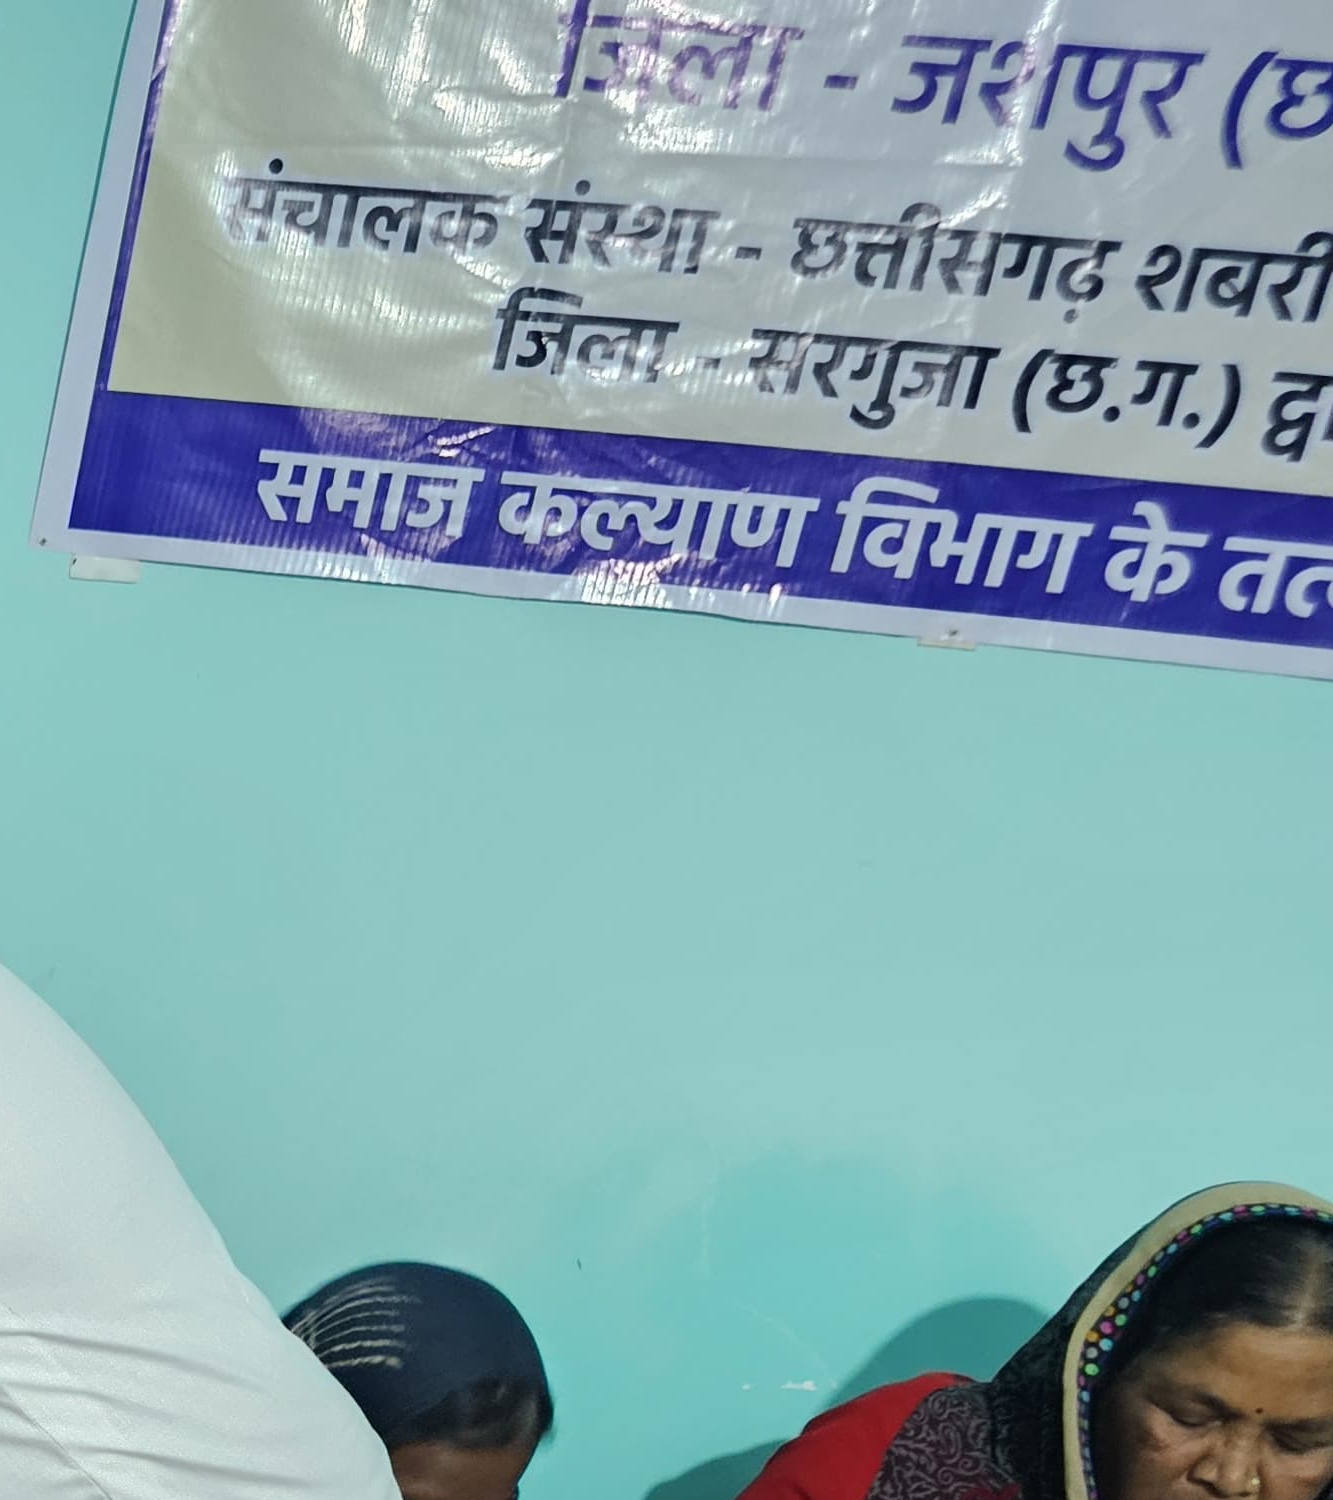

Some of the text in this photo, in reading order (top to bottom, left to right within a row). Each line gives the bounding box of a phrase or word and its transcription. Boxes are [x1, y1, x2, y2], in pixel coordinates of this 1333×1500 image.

[891, 35, 1207, 172] जशपुर
[225, 158, 513, 254] संचालक
[523, 179, 722, 274] संस्था
[790, 202, 1123, 324] छत्तीसगढ़
[493, 287, 680, 384] जिला
[749, 328, 1000, 430] सरगुजा
[257, 448, 485, 542] समाज
[498, 469, 820, 569] कल्याण
[830, 476, 1094, 595] विभाग
[1104, 501, 1211, 603] के
